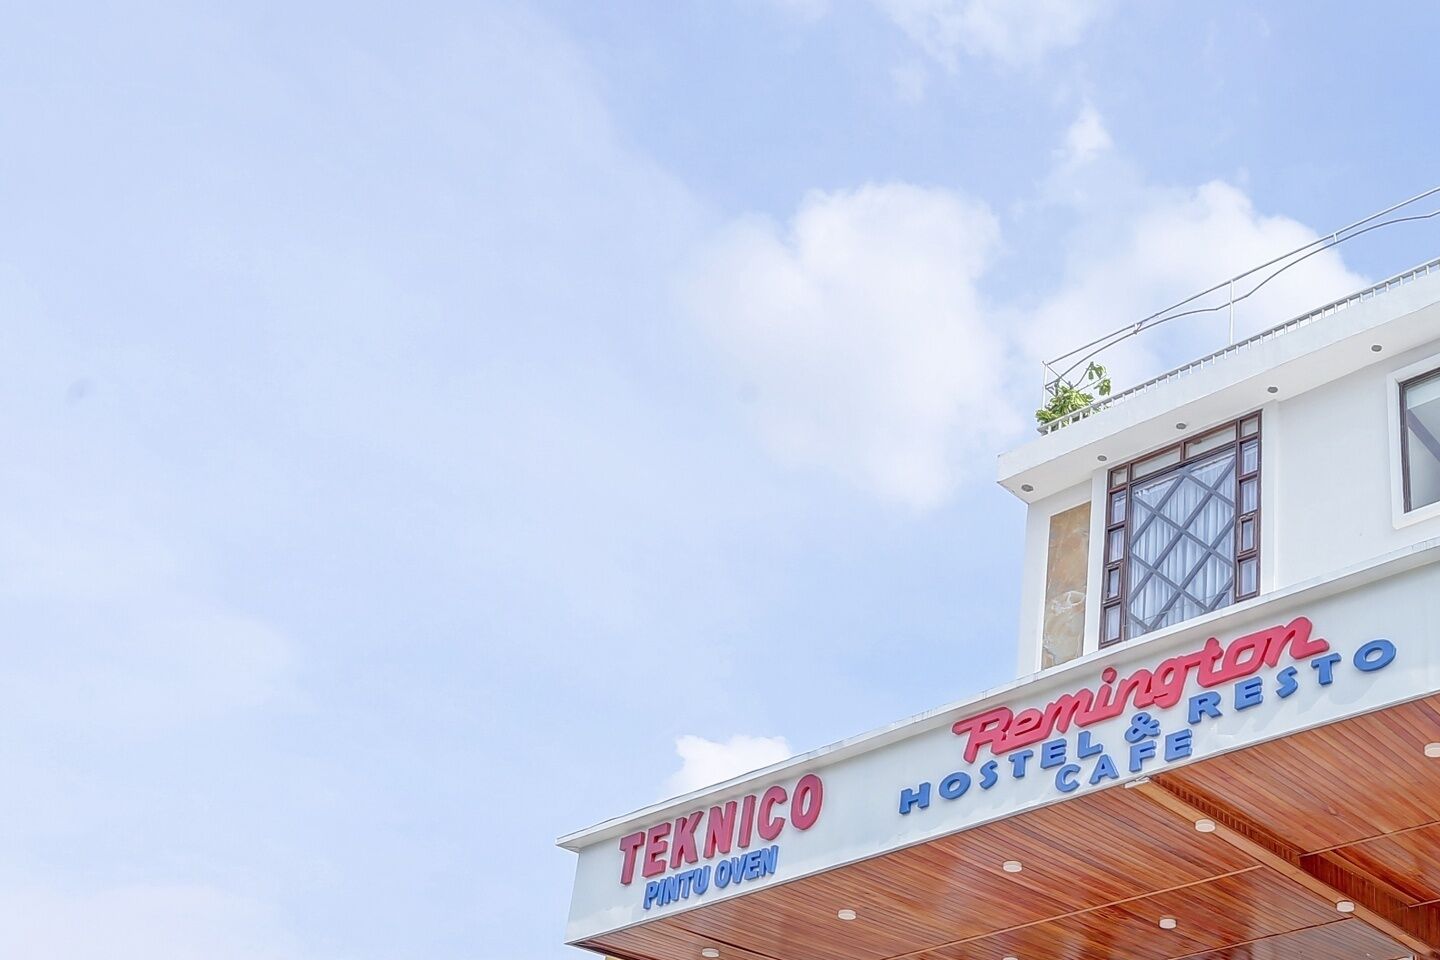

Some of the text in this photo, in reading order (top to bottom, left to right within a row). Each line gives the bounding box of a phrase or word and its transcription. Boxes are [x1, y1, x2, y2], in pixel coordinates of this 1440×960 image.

[899, 638, 1396, 814] HOSTEL & RESTO
[952, 616, 1329, 764] Remington
[1055, 729, 1192, 792] CAFE
[620, 774, 823, 884] TEKNICO
[643, 845, 779, 909] PINTU OVEN
